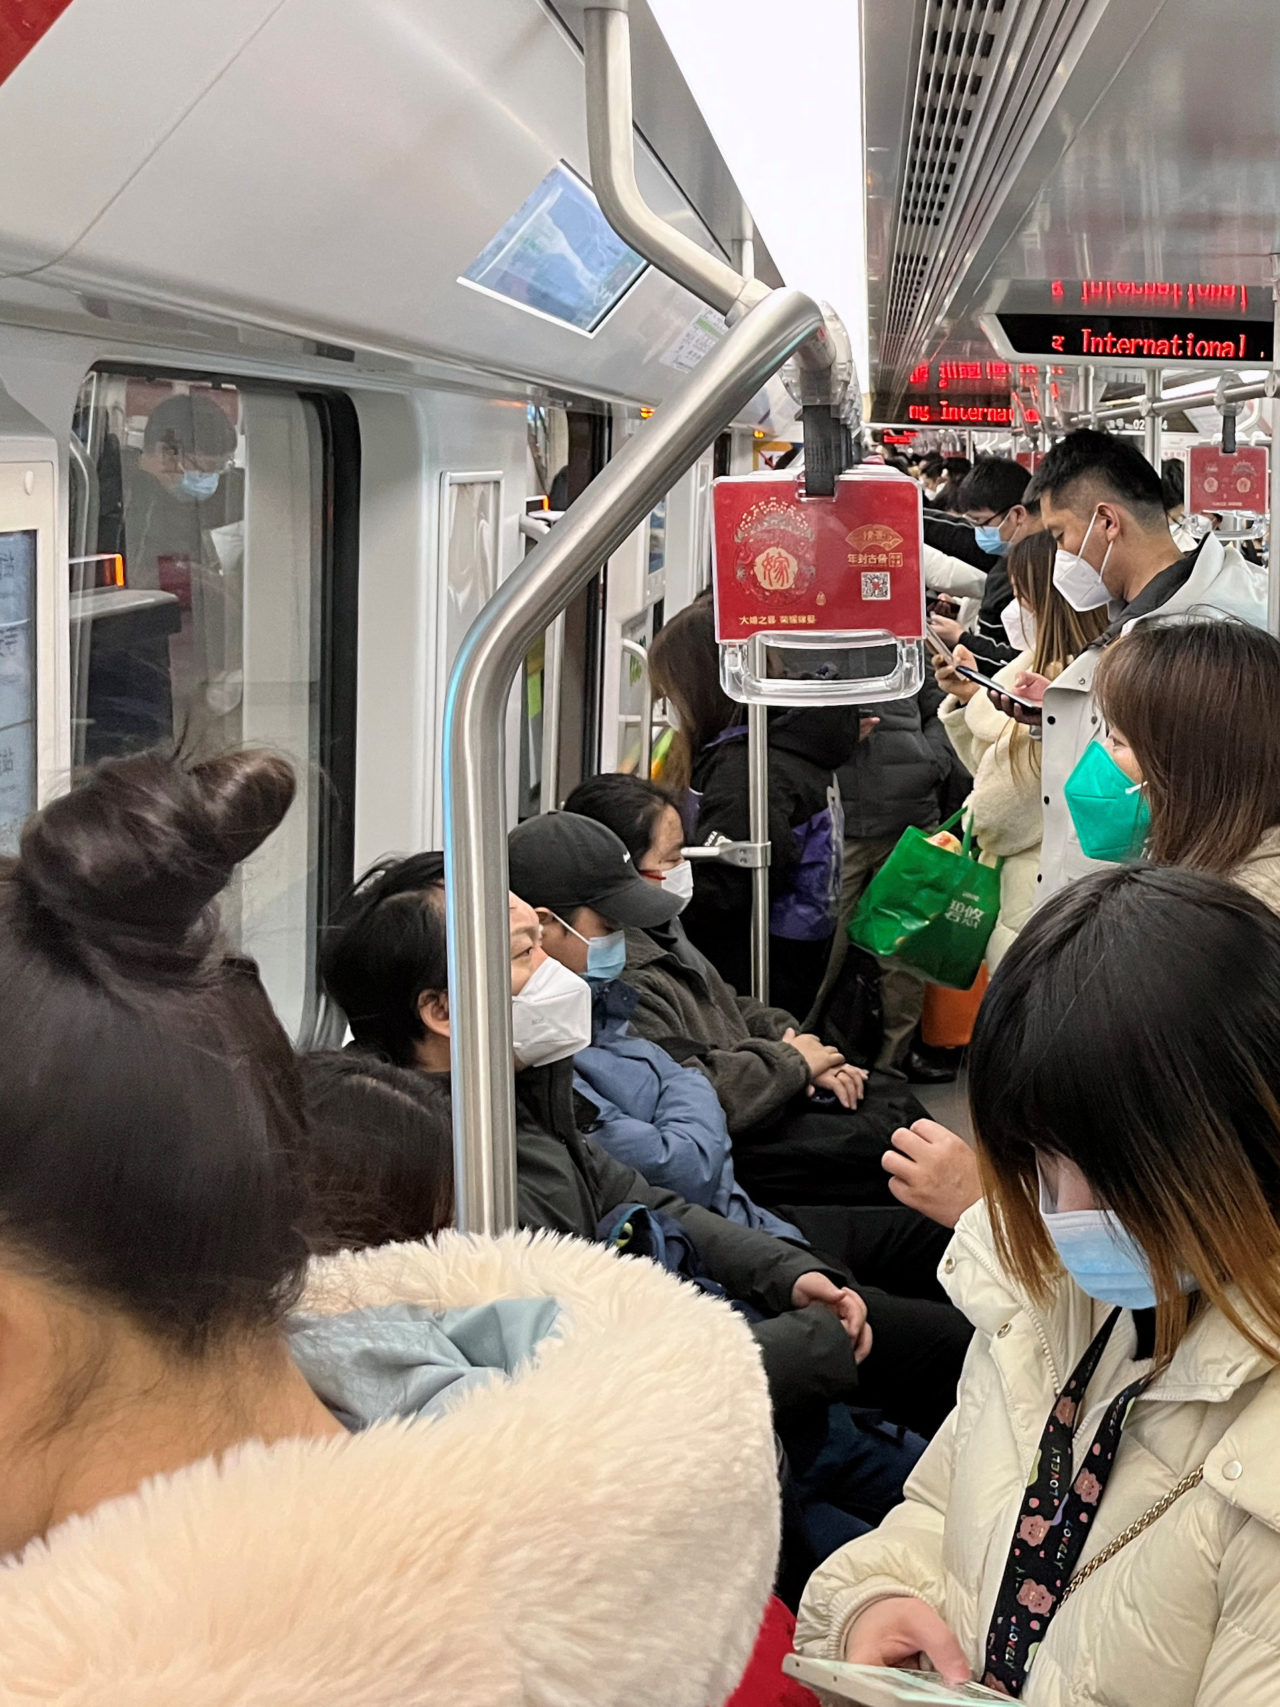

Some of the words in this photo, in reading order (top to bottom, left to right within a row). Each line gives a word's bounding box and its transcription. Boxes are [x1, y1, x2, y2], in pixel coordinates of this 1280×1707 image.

[1081, 328, 1246, 358] International
[1049, 1447, 1061, 1496] LOVELY
[1053, 1519, 1073, 1570] LOVELY
[1004, 1624, 1020, 1670] LOVELY
